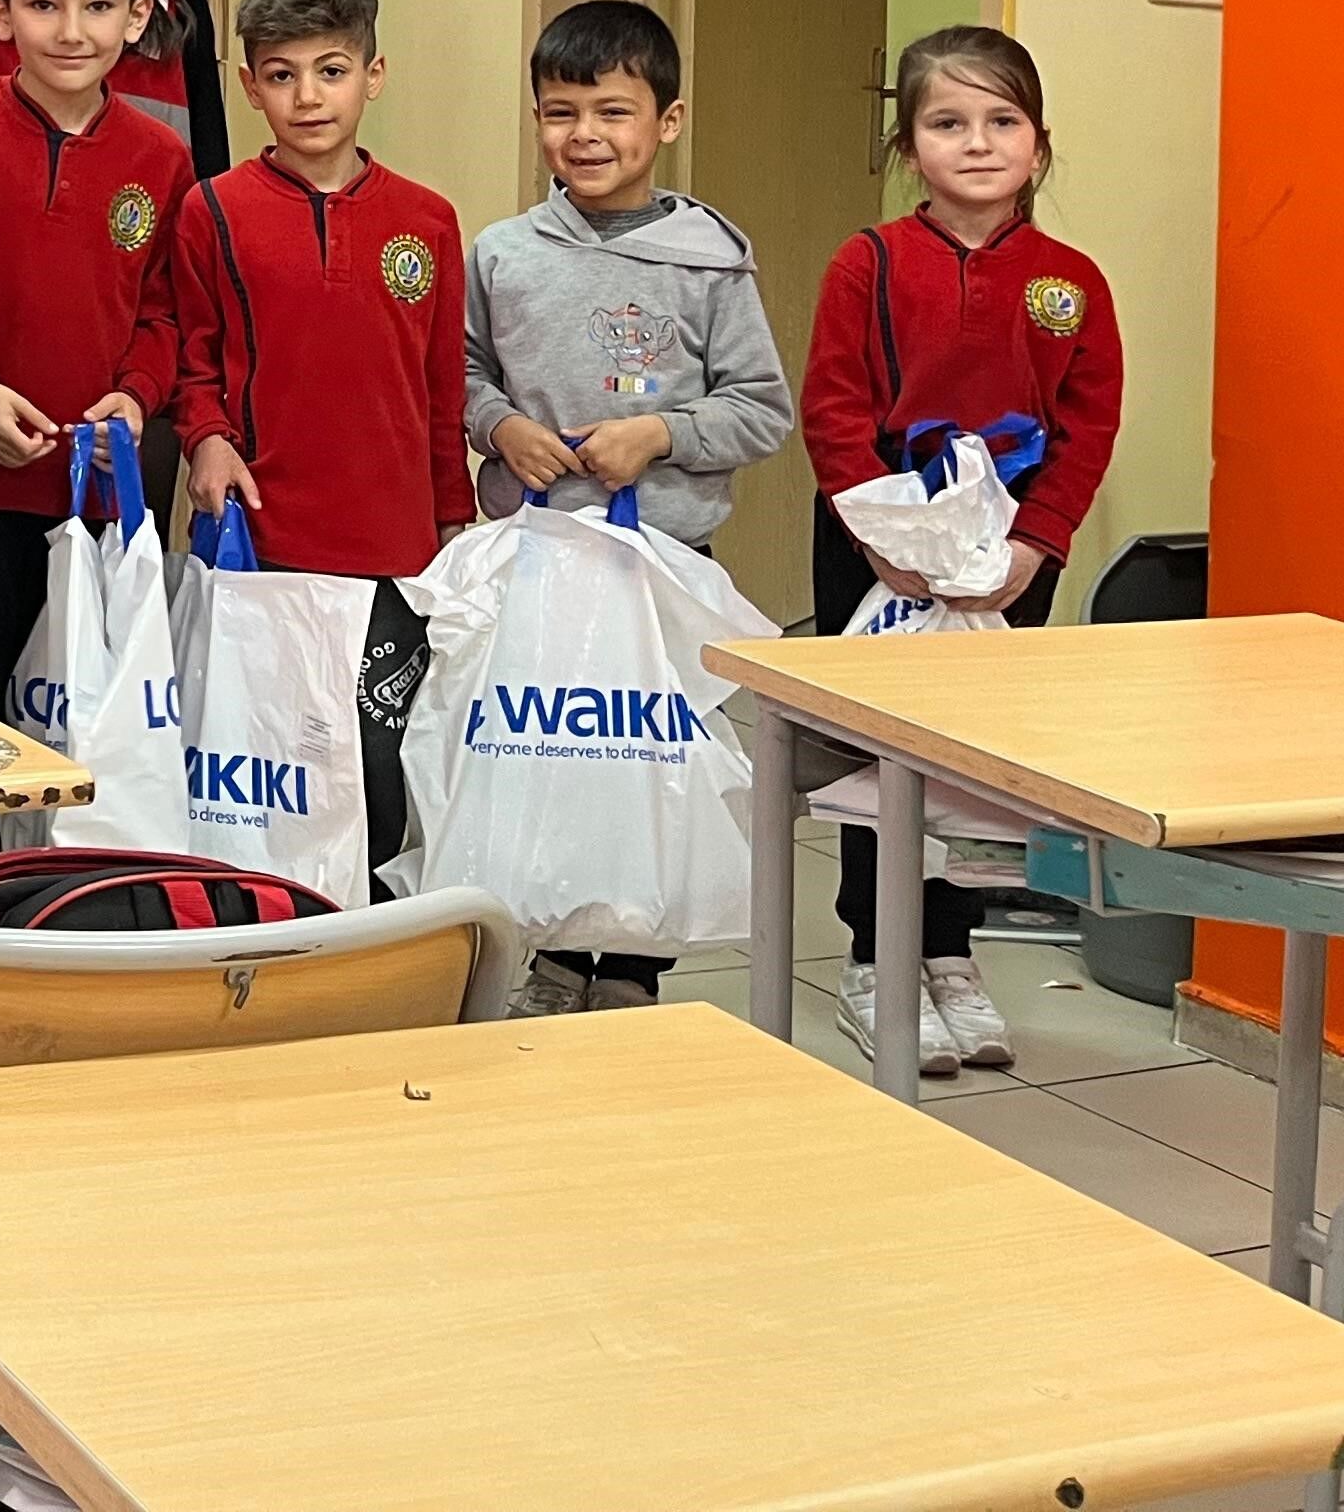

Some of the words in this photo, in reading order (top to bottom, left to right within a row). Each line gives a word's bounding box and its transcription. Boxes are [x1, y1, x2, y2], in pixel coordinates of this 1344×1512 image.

[385, 715, 409, 730] AN
[535, 741, 603, 759] deserves
[606, 744, 620, 759] to
[656, 747, 686, 764] well
[200, 806, 238, 825] dress
